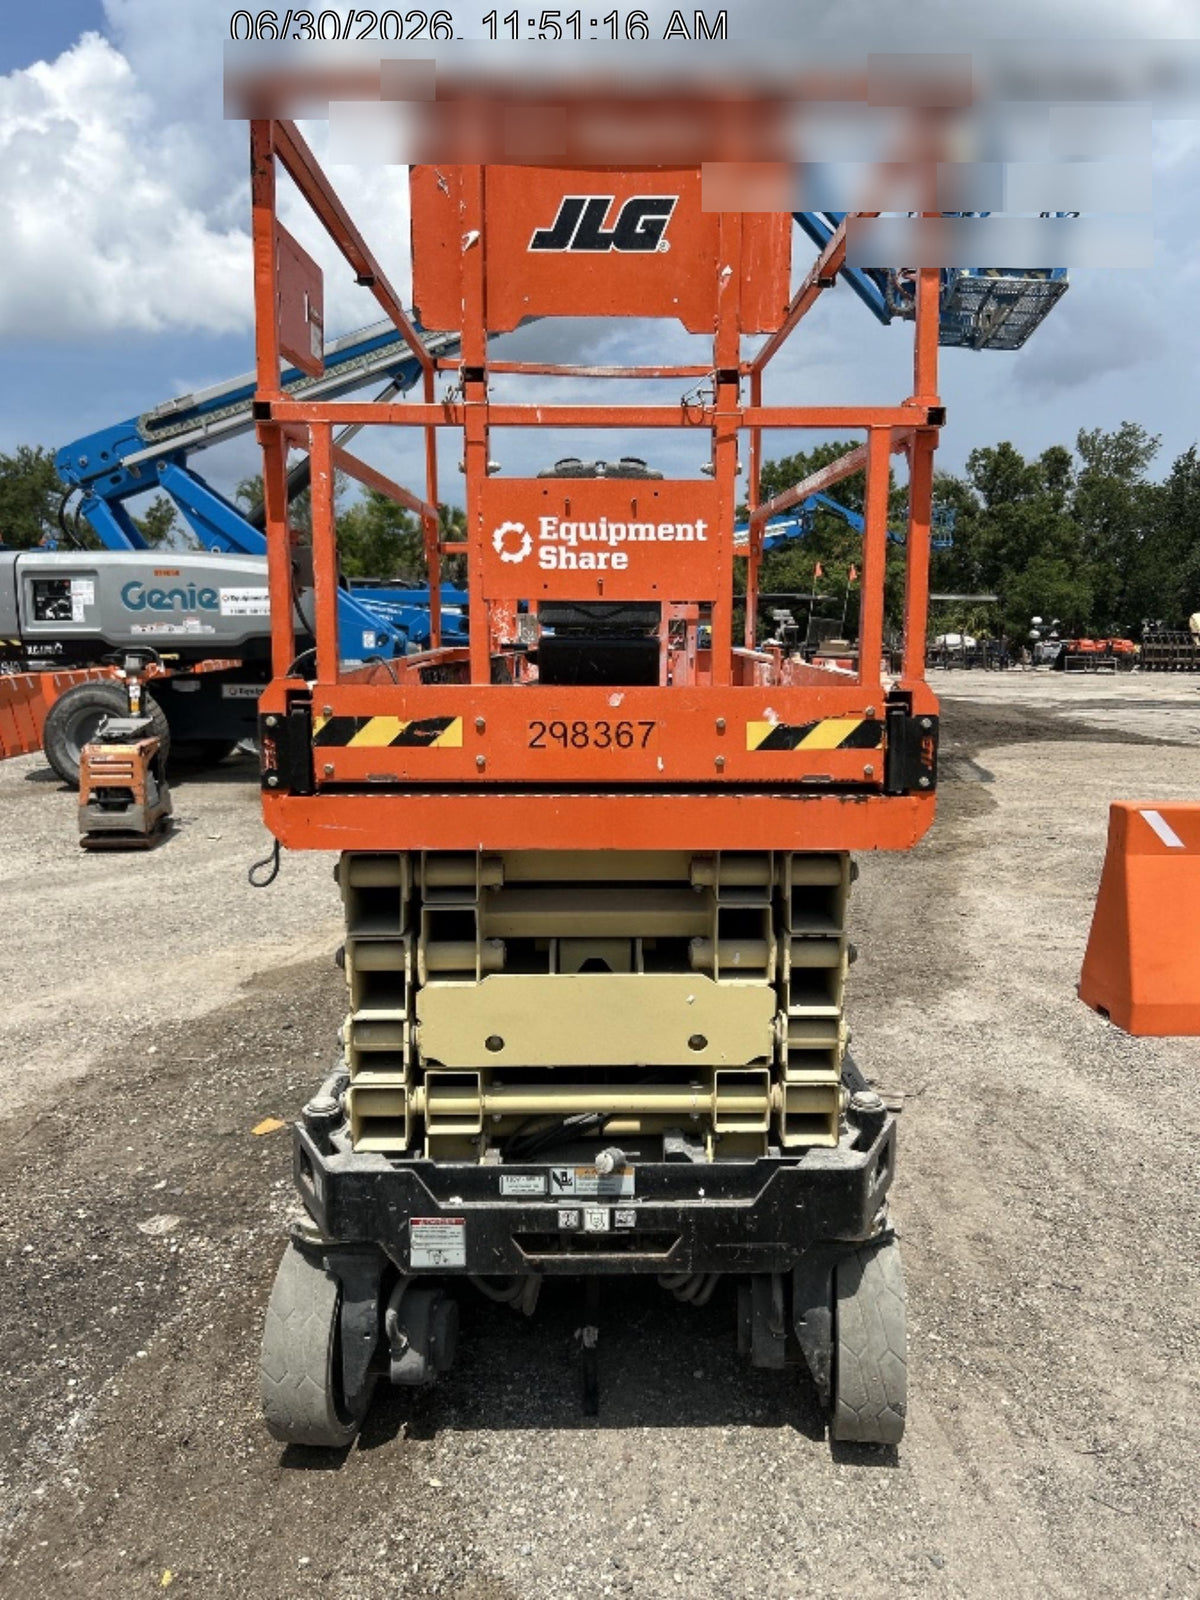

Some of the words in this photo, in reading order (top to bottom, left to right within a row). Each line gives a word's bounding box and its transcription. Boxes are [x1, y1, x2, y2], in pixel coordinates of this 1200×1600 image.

[527, 195, 680, 253] JLG
[538, 516, 708, 546] Equipment
[538, 545, 629, 570] Share
[120, 580, 219, 612] Genie
[528, 721, 656, 748] 298367
